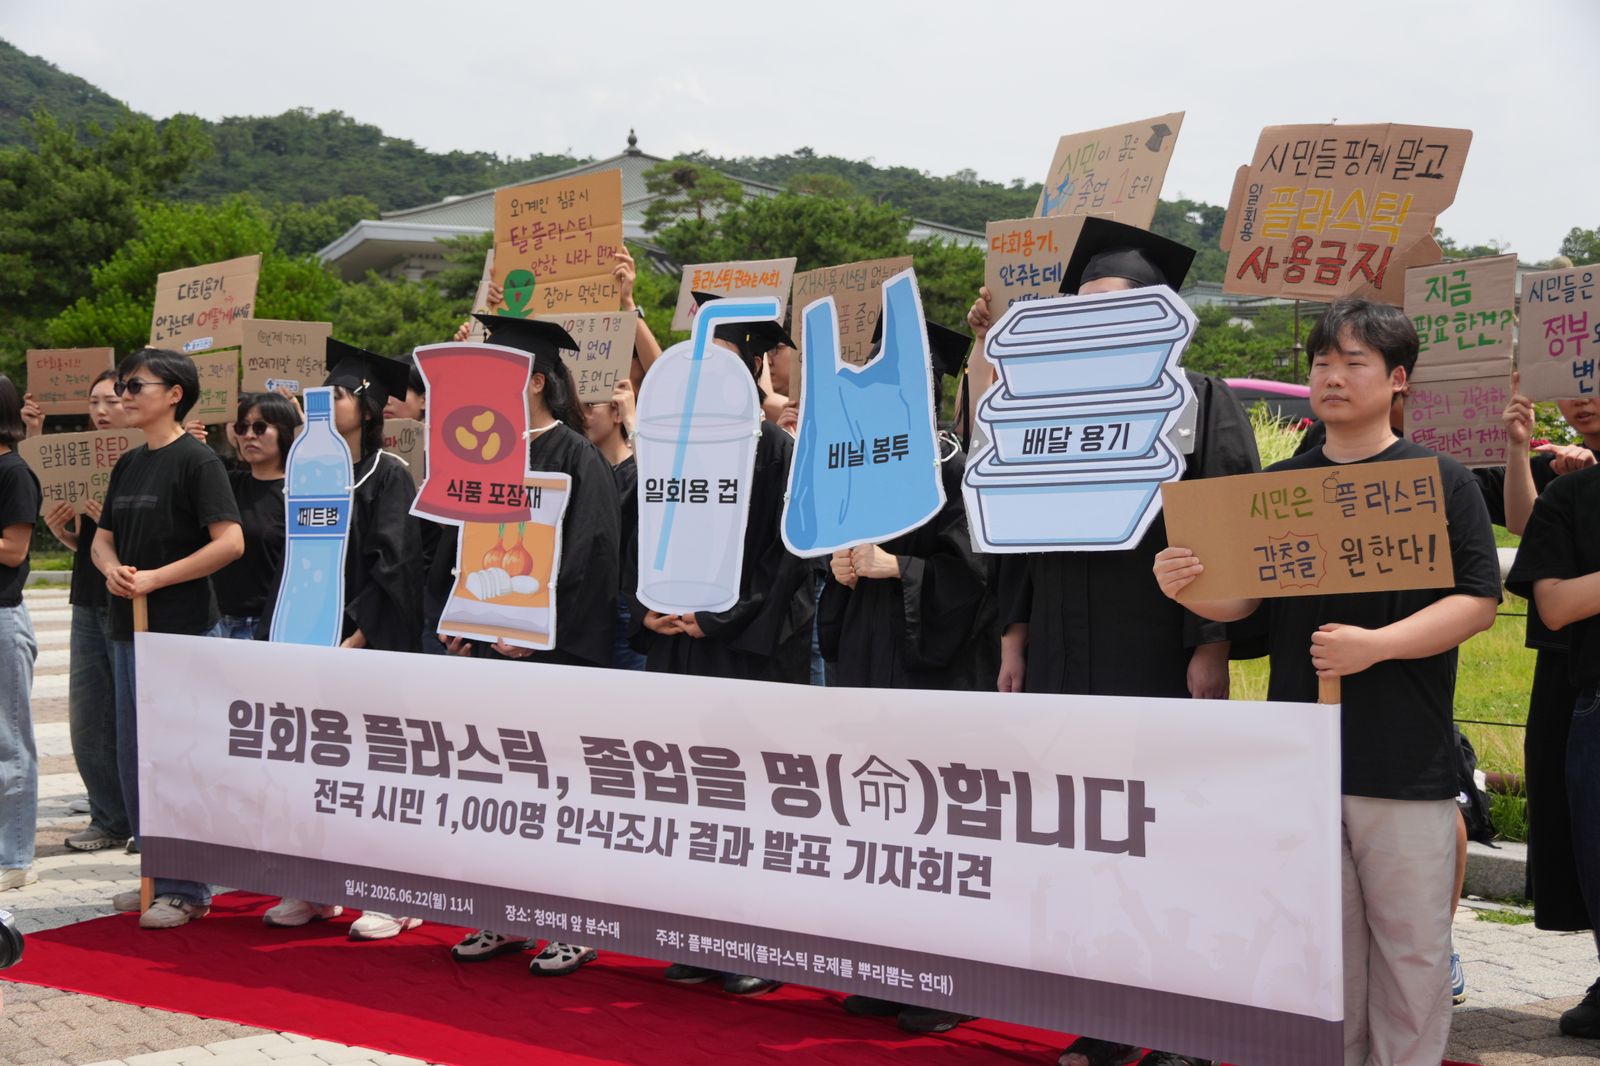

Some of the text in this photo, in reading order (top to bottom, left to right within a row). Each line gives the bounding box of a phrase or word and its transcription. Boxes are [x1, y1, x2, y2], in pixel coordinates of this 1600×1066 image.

[1057, 142, 1111, 175] 시민이
[1260, 138, 1338, 178] 시민들
[1392, 137, 1449, 180] 말고
[510, 196, 549, 218] 외계인
[1260, 186, 1415, 245] 플라스틱
[566, 249, 592, 265] 나라
[991, 229, 1059, 257] 다회용기,
[1236, 235, 1394, 290] 사용금지
[578, 283, 619, 305] 먹힌다
[1424, 269, 1472, 308] 지금
[1528, 272, 1595, 303] 시민들은
[1410, 385, 1506, 422] 정부의 강력한
[40, 436, 129, 469] 일회용품 RED
[828, 433, 909, 469] 비닐 봉투
[1022, 422, 1131, 455] 배달 용기
[1474, 424, 1508, 459] 정책
[96, 453, 122, 469] RE
[42, 480, 90, 503] 다회용기
[447, 479, 542, 509] 식품 포장재
[645, 478, 738, 504] 일회용 컵
[1250, 475, 1437, 520] 시민은 플라스틱
[298, 507, 338, 527] 페트병
[1253, 533, 1437, 582] 감축을 원한다!
[228, 700, 1156, 858] 일회용 플라스틱, 졸업을 명(命)합니다
[313, 778, 993, 900] 전국 시민 1,000명 인식조사 결과 발표 기자회견
[344, 879, 954, 996] 일시: 2026.06.22(월) 11시 장소: 청와대 앞 분수대 주최: 플뿌리연대(플라스틱 문제를 뿌리뽑는 연대)
